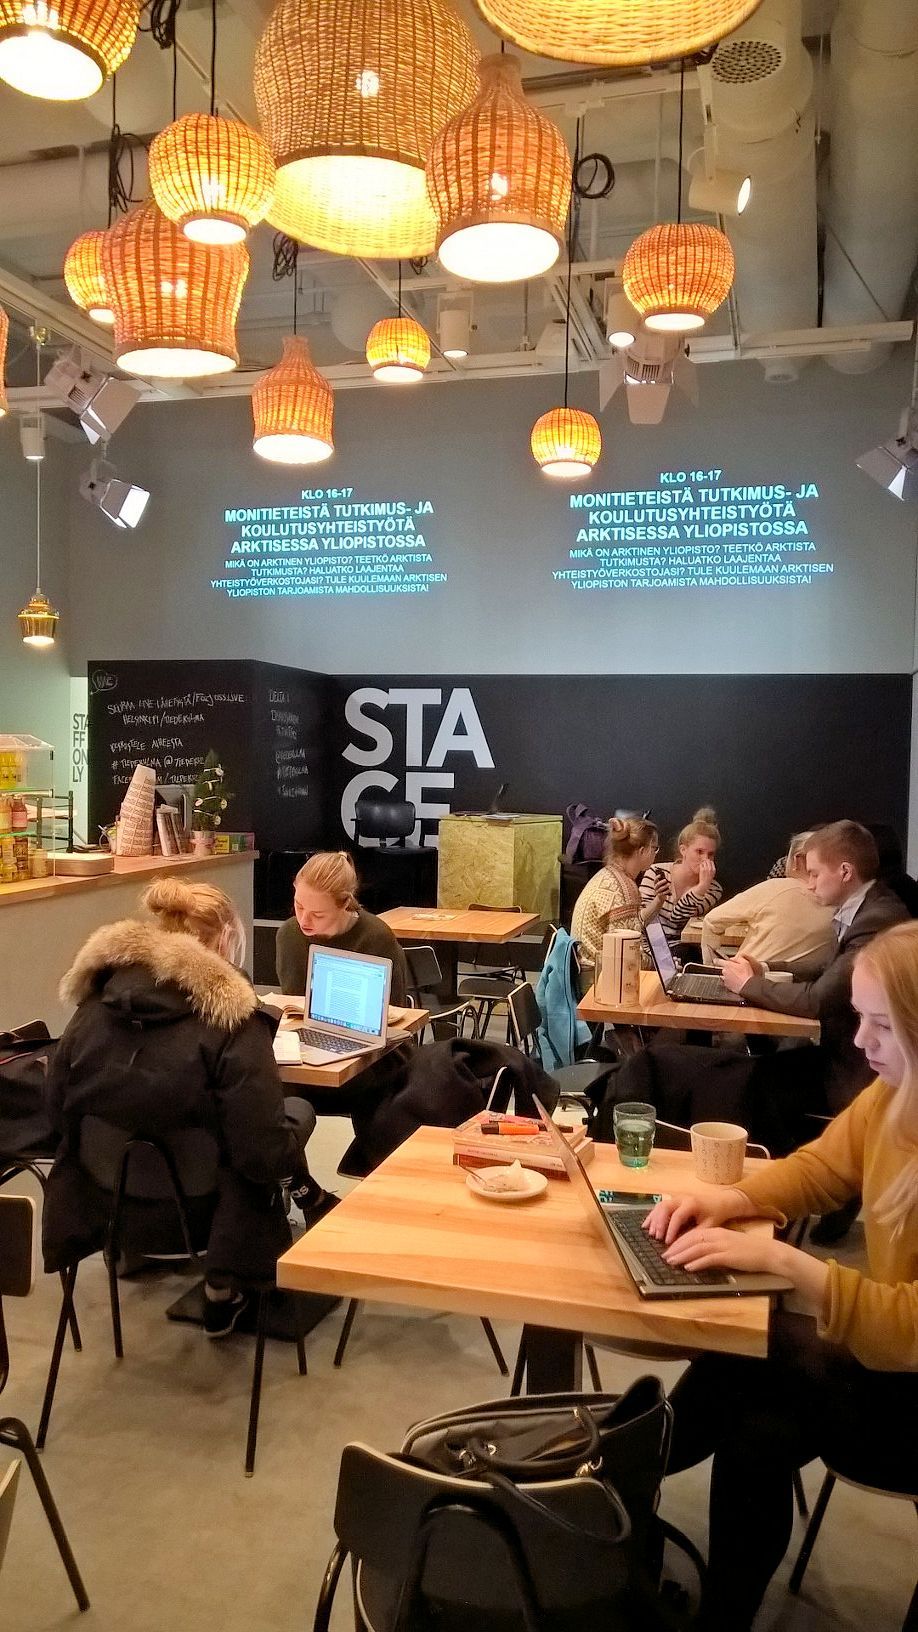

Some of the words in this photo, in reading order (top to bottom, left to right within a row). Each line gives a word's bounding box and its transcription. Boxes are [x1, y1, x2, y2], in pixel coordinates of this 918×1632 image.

[660, 472, 686, 483] KLO
[690, 470, 722, 482] 16-17
[301, 489, 323, 499] KLO
[326, 488, 353, 498] 16-17
[570, 487, 694, 508] MONITIETEISTÄ
[698, 485, 792, 502] TUTKIMUS-
[796, 484, 819, 498] JA
[225, 503, 330, 522] MONITIETEISTÄ
[333, 502, 411, 517] TUTKIMUS-
[415, 501, 434, 514] JA
[589, 501, 796, 524] KOULUTUSYHTEISTYÖTÄ
[241, 516, 415, 537] KOULUTUSYHTEISTYÖTÄ
[576, 525, 680, 542] ARKTISESSA
[683, 520, 809, 538] YLIOPISTOSSA
[230, 538, 319, 554] ARKTISESSA
[322, 535, 426, 549] YLIOPISTOSSA
[569, 547, 593, 558] MIKÄ
[595, 549, 610, 557] ON
[611, 547, 661, 556] ARKTINEN
[663, 545, 720, 555] YLIOPISTO?
[723, 542, 763, 553] TEETKÖ
[765, 542, 816, 552] ARKTISTA
[225, 558, 246, 568] MIKÄ
[247, 559, 260, 567] ON
[261, 557, 302, 567] ARKTINEN
[304, 555, 353, 565] YLIOPISTO?
[355, 553, 389, 563] TEETKÖ
[390, 553, 433, 563] ARKTISTA
[600, 557, 666, 567] TUTKIMUSTA?
[669, 555, 721, 565] HALUATKO
[724, 553, 782, 563] LAAJENTAA
[251, 567, 308, 577] TUTKIMUSTA?
[309, 566, 354, 575] HALUATKO
[356, 564, 404, 573] LAAJENTAA
[552, 567, 685, 580] YHTEISTYÖVERKOSTOJASI?
[688, 566, 713, 576] TULE
[715, 564, 779, 575] KUULEMAAN
[781, 563, 834, 573] ARKTISEN
[210, 576, 323, 588] YHTEISTYÖVERKOSTOJASI?
[326, 575, 347, 584] TULE
[348, 574, 402, 583] KUULEMAAN
[403, 573, 447, 582] ARKTISEN
[571, 579, 628, 589] YLIOPISTON
[631, 577, 698, 587] TARJOAMISTA
[699, 575, 812, 586] MAHDOLLISUUKSISTA!
[227, 587, 276, 597] YLIOPISTON
[277, 585, 334, 595] TARJOAMISTA
[336, 583, 429, 594] MAHDOLLISUUKSISTA!
[341, 687, 496, 769] STA
